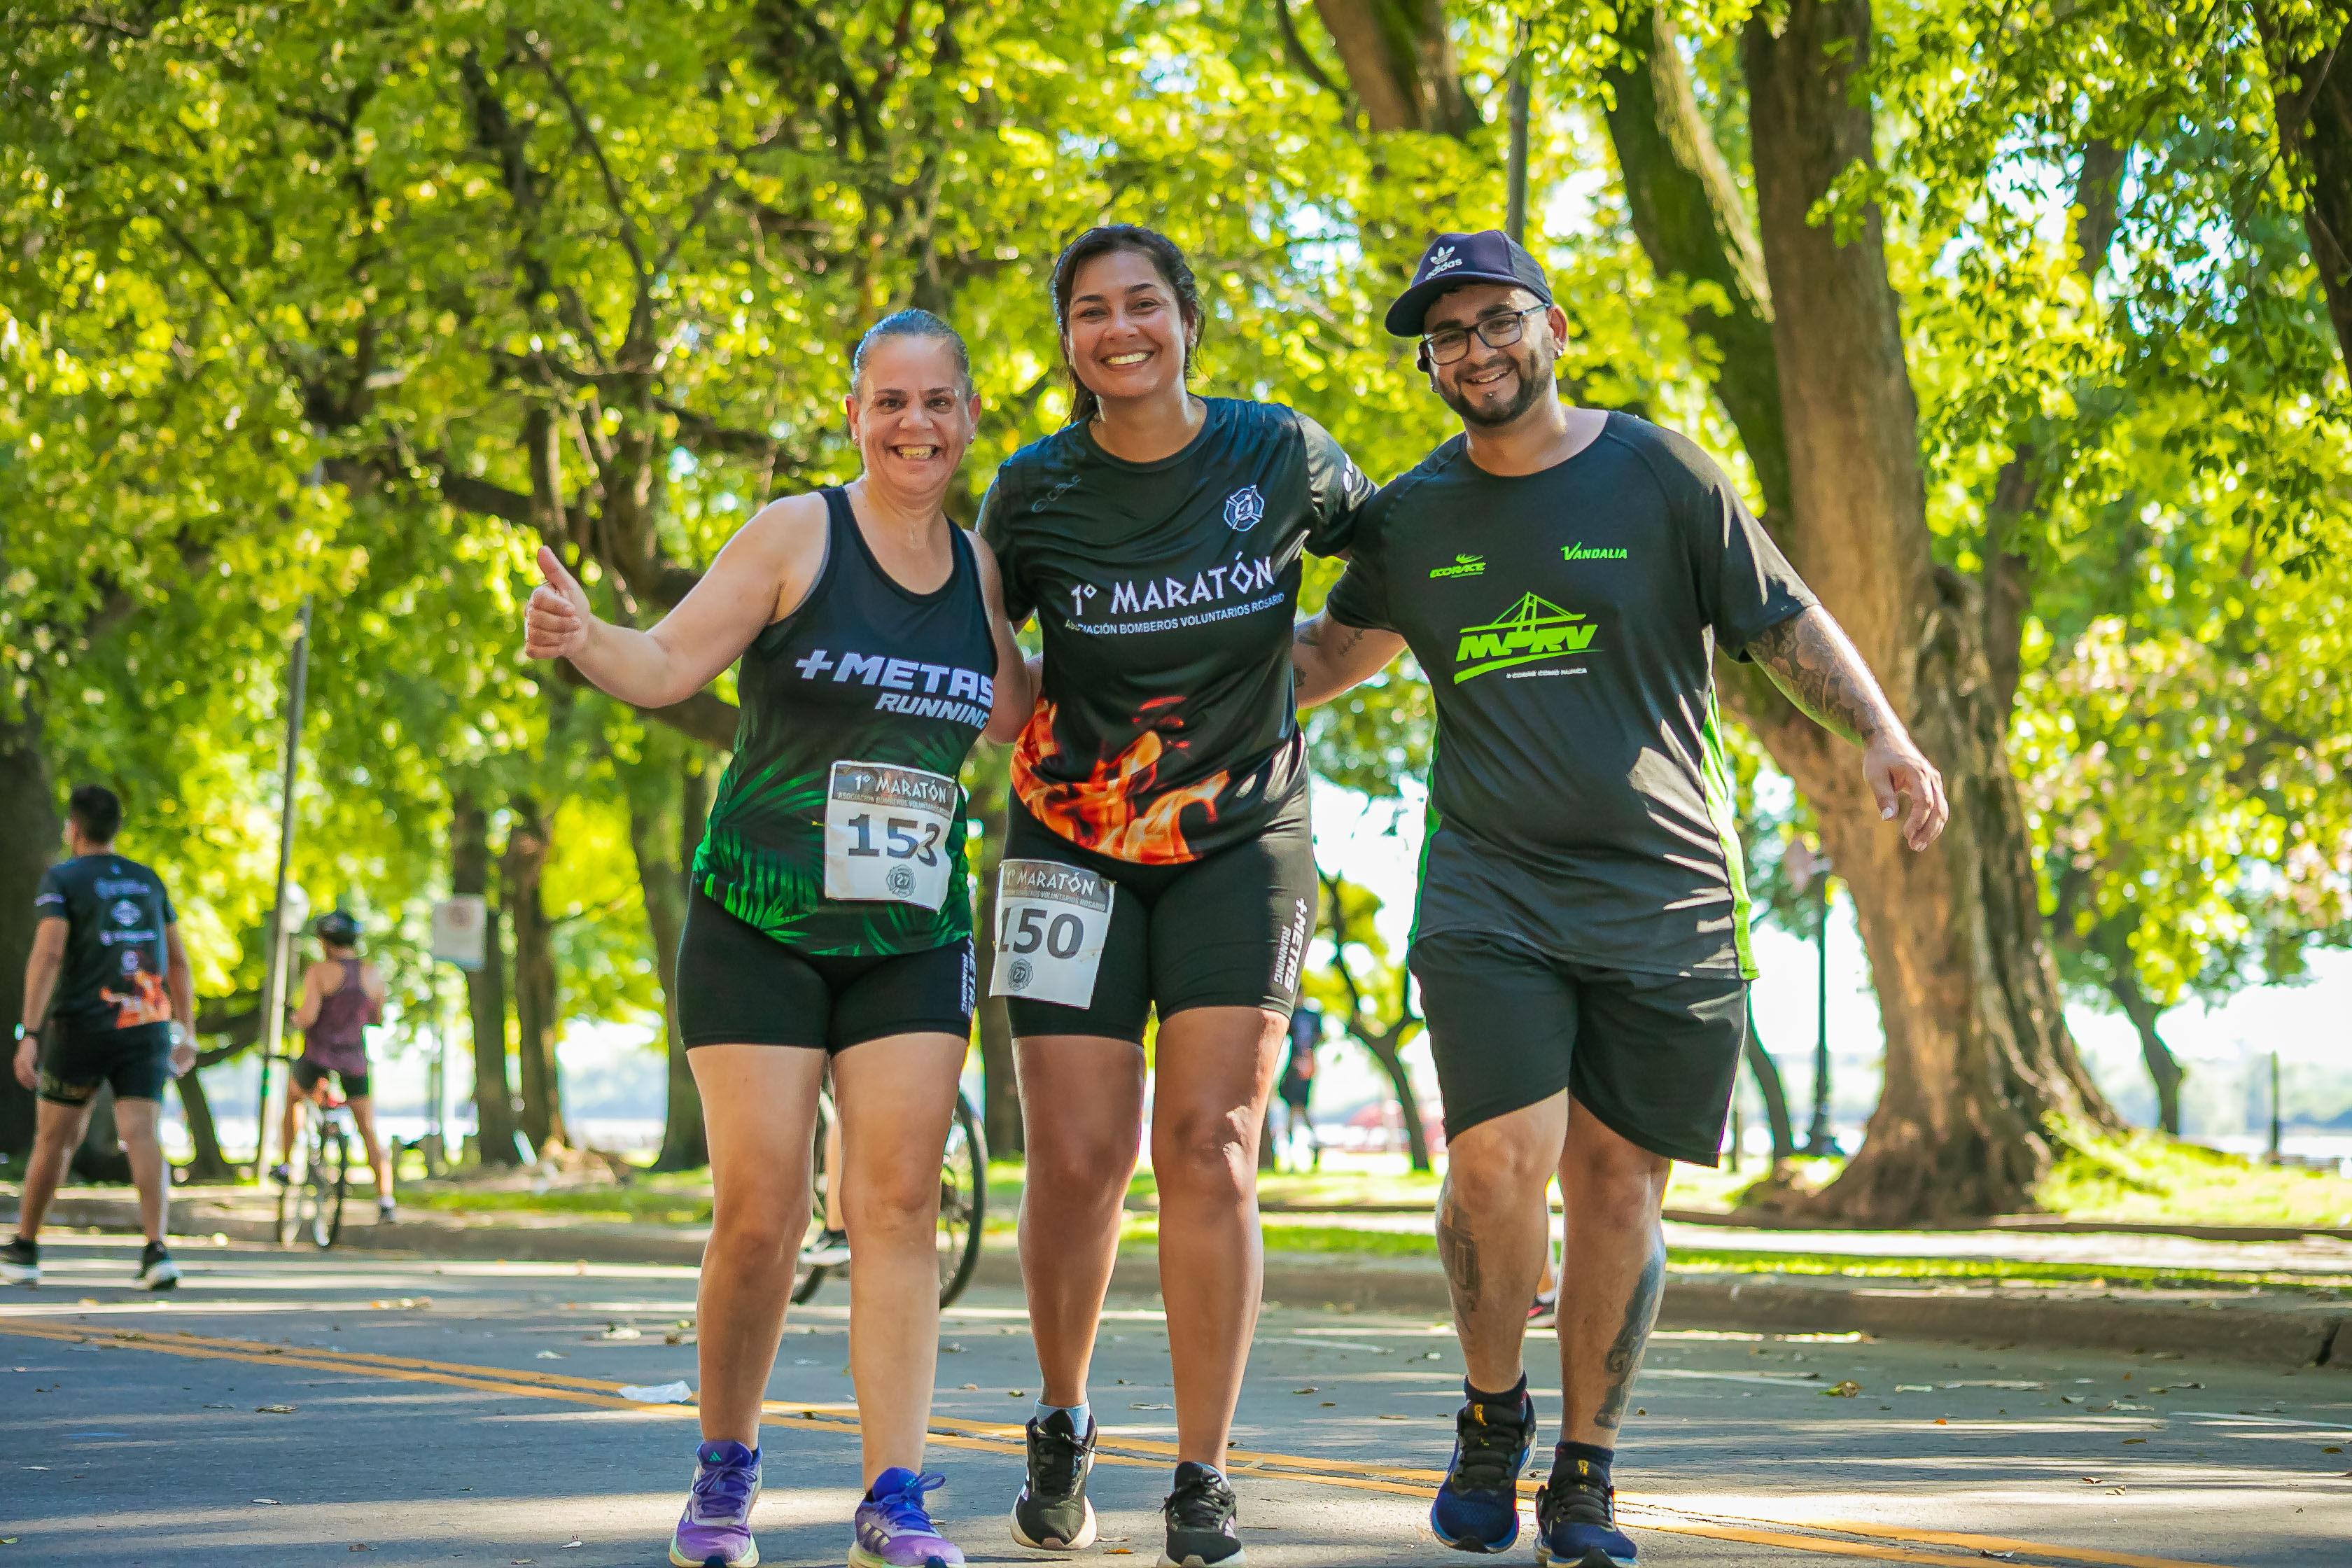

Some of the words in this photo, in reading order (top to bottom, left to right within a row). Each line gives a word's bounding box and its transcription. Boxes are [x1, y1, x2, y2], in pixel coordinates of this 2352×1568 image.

[1424, 258, 1463, 280] adidas
[1561, 541, 1628, 560] VANDALIA
[1110, 550, 1275, 615] MARATÓN
[1120, 617, 1179, 634] BOMBEROS
[1180, 603, 1250, 627] VOLUNTARIOS
[1251, 592, 1284, 612] ROSARIO
[875, 692, 990, 730] RUNNING
[875, 774, 946, 804] MARATÓN
[848, 813, 941, 867] 153
[1016, 870, 1096, 897] MARATÓN
[1040, 891, 1079, 904] VOLUNTARIOS
[1273, 925, 1292, 985] RUNNING
